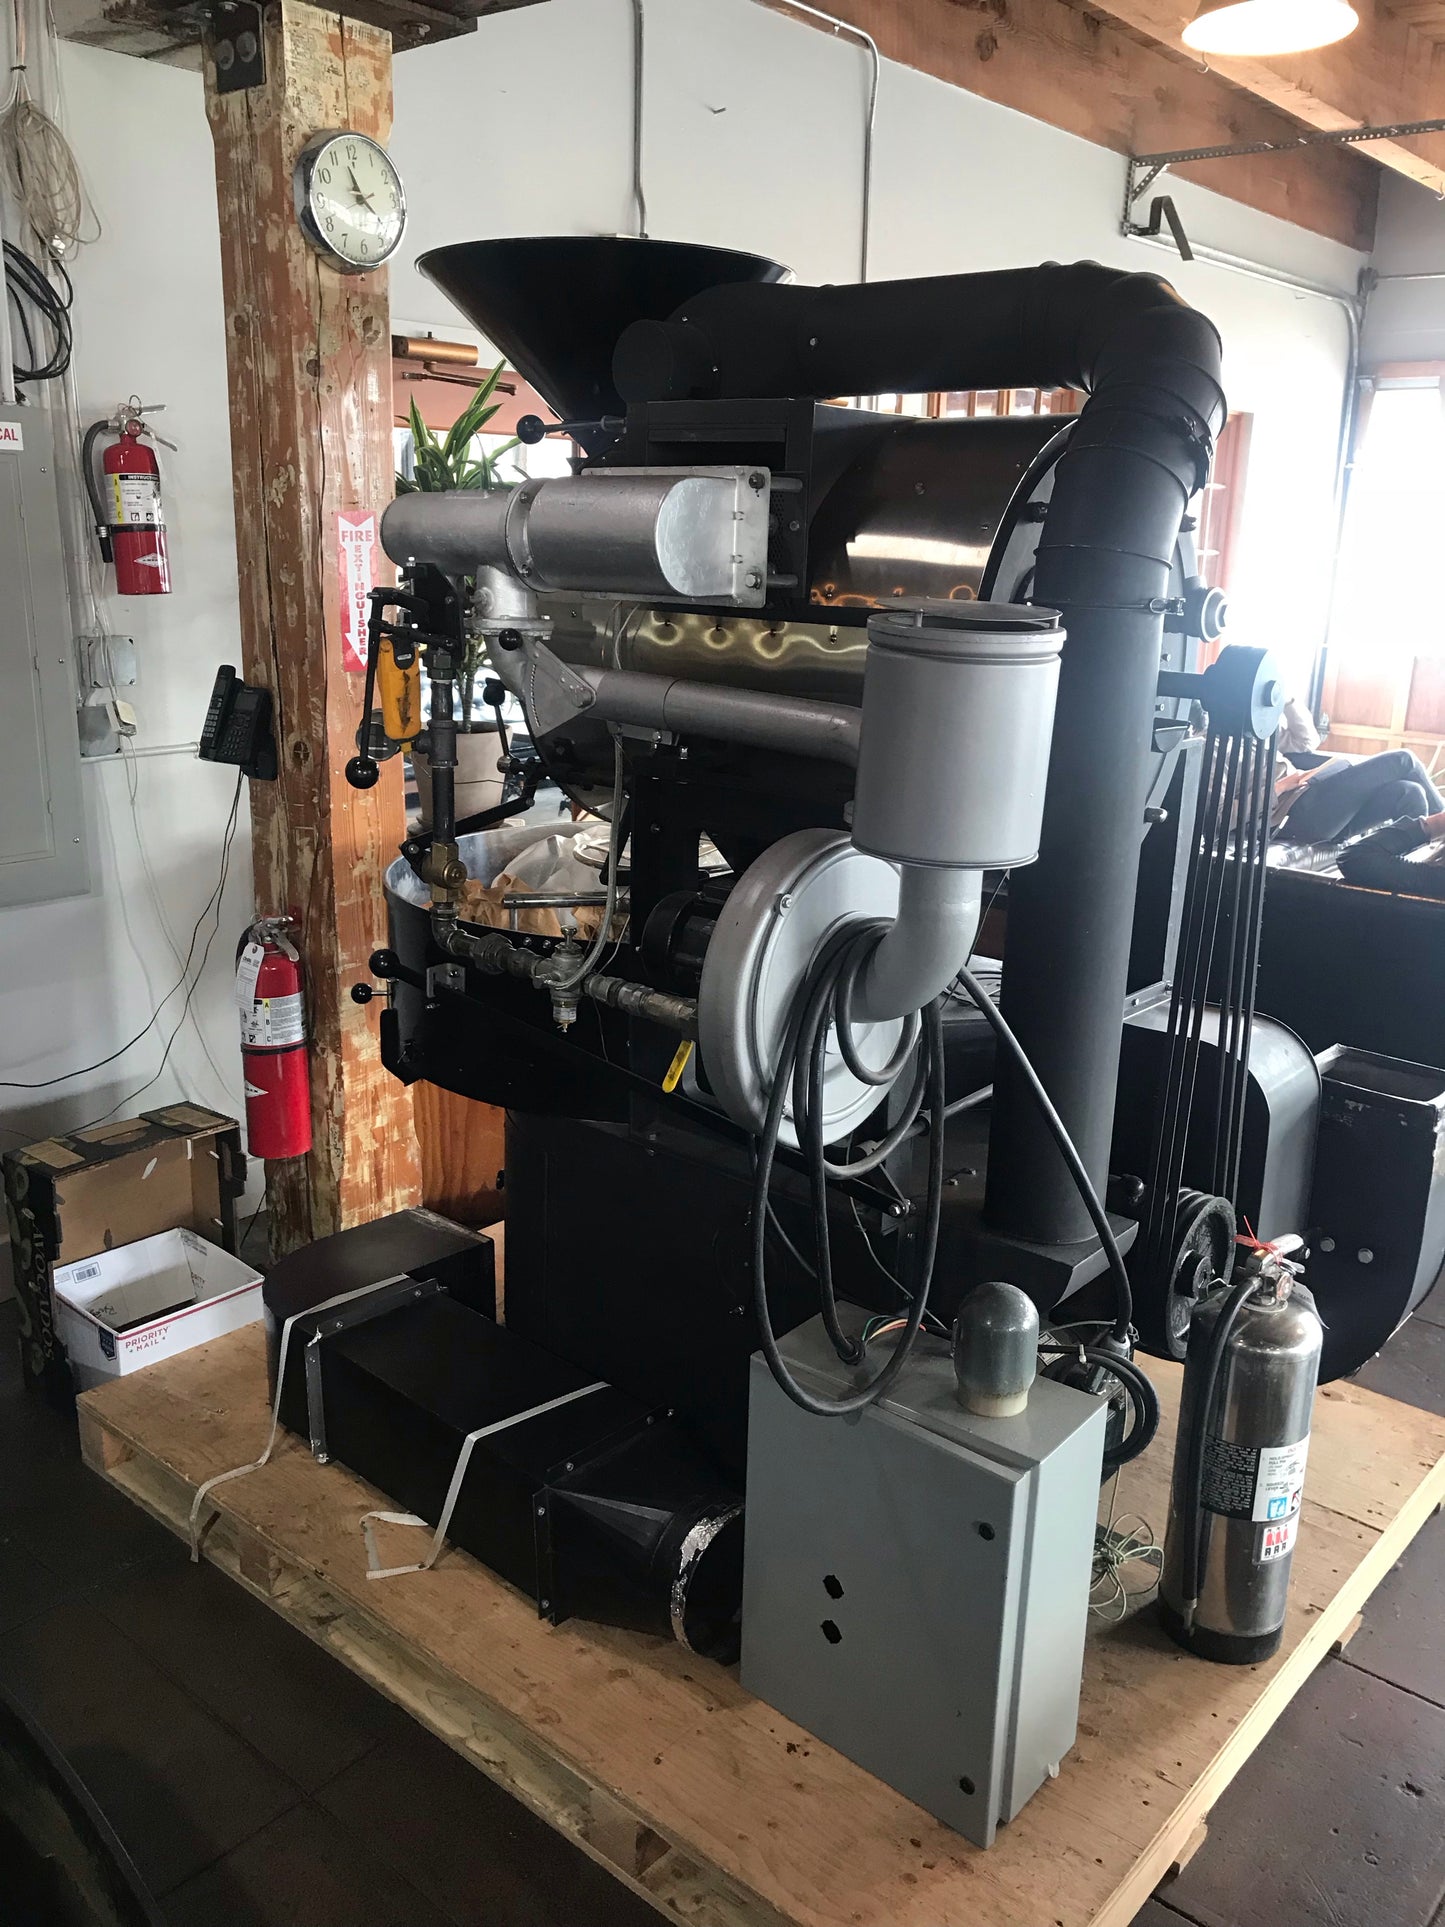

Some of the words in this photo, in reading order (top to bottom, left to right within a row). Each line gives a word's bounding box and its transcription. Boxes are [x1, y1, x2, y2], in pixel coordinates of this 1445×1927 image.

[329, 150, 339, 166] 11
[346, 144, 358, 161] 12
[369, 153, 374, 168] 1
[318, 167, 332, 184] 10
[381, 169, 389, 185] 2
[316, 191, 326, 209] 9
[389, 192, 397, 209] 3
[325, 216, 335, 232] 8
[341, 233, 349, 248] 7
[360, 238, 368, 255] 6
[341, 530, 373, 542] FIRE
[353, 544, 368, 655] EXTINGUISHER
[32, 1221, 55, 1361] AVOCADOS
[125, 1326, 169, 1349] PRIORITY
[136, 1339, 159, 1352] MAIL
